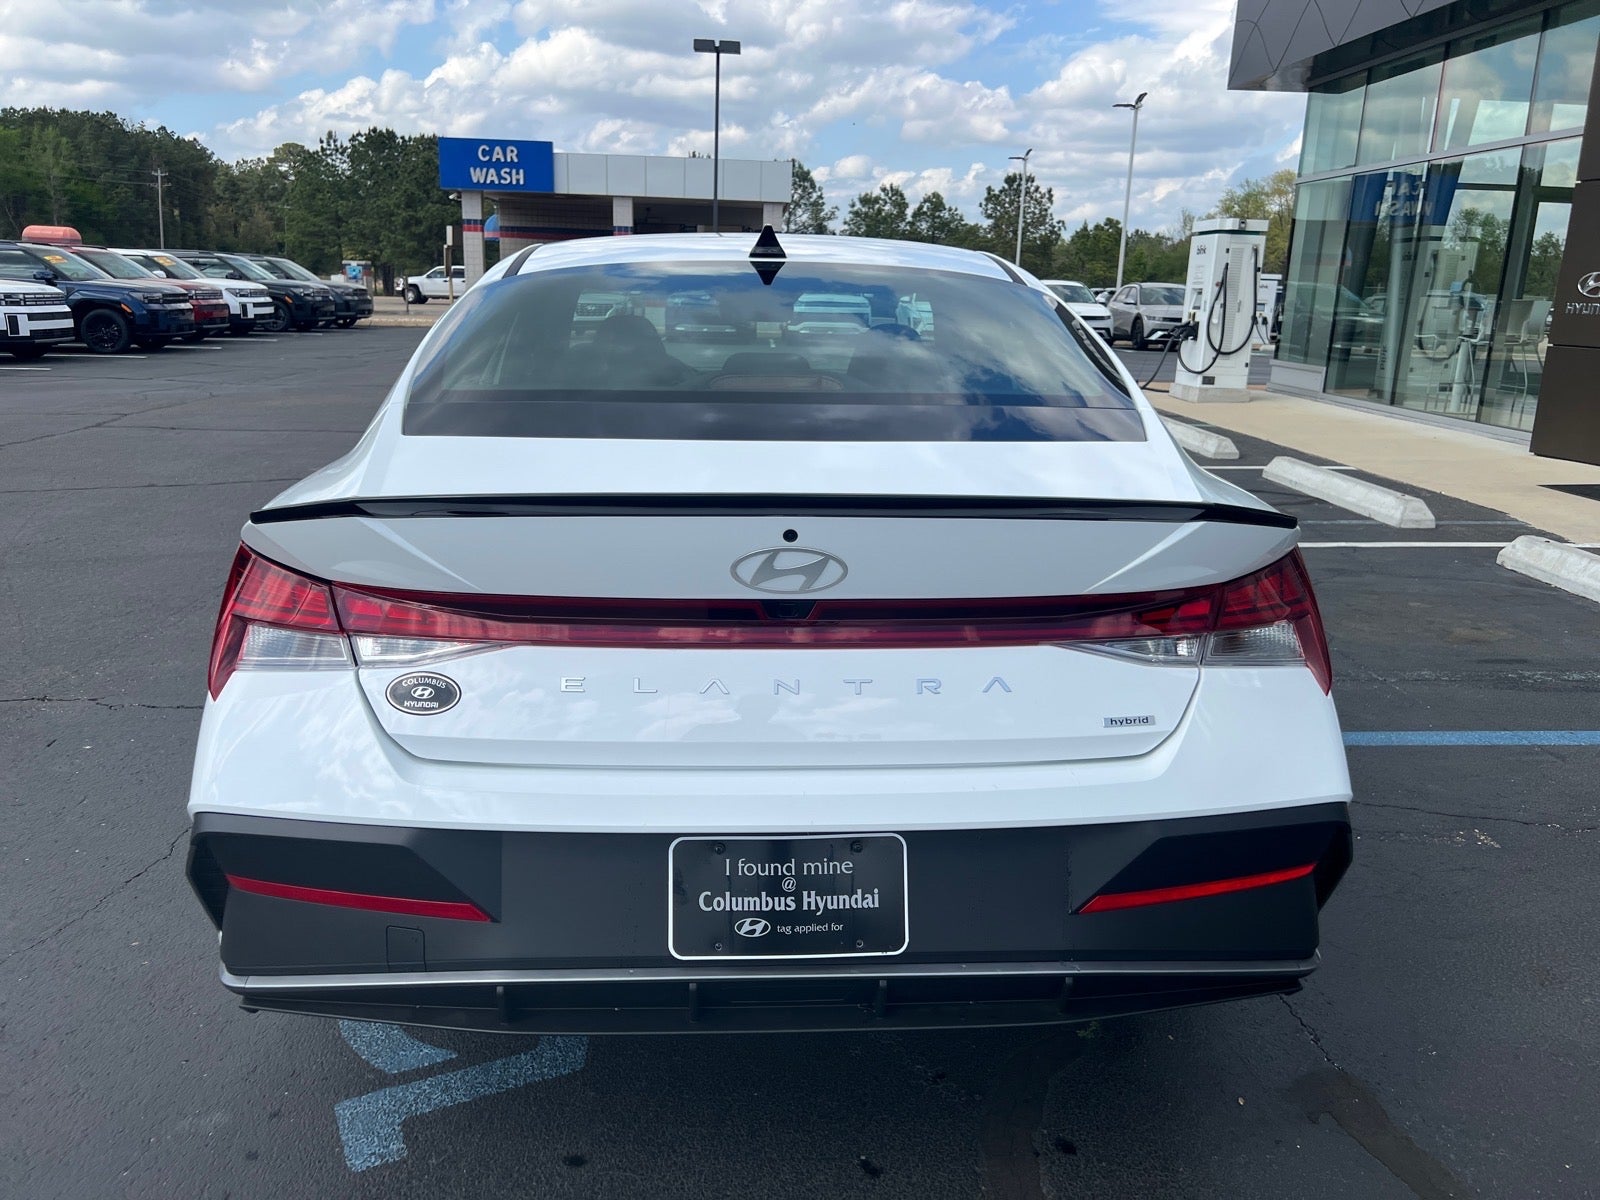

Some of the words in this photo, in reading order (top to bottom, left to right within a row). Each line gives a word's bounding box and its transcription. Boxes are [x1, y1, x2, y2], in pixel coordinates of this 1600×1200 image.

[478, 145, 518, 162] CAR
[470, 167, 524, 185] WASH
[1565, 302, 1600, 315] HYUN
[402, 678, 446, 689] COLUMBUS
[559, 676, 1013, 695] ELANTRA
[1110, 716, 1149, 726] hybrid
[725, 858, 730, 876] I
[737, 858, 796, 876] found
[803, 857, 853, 875] mine
[781, 876, 797, 892] @
[698, 891, 797, 912] Columbus
[802, 888, 880, 916] Hyundai
[777, 924, 792, 935] tag
[794, 922, 828, 934] applied
[831, 922, 843, 932] for
